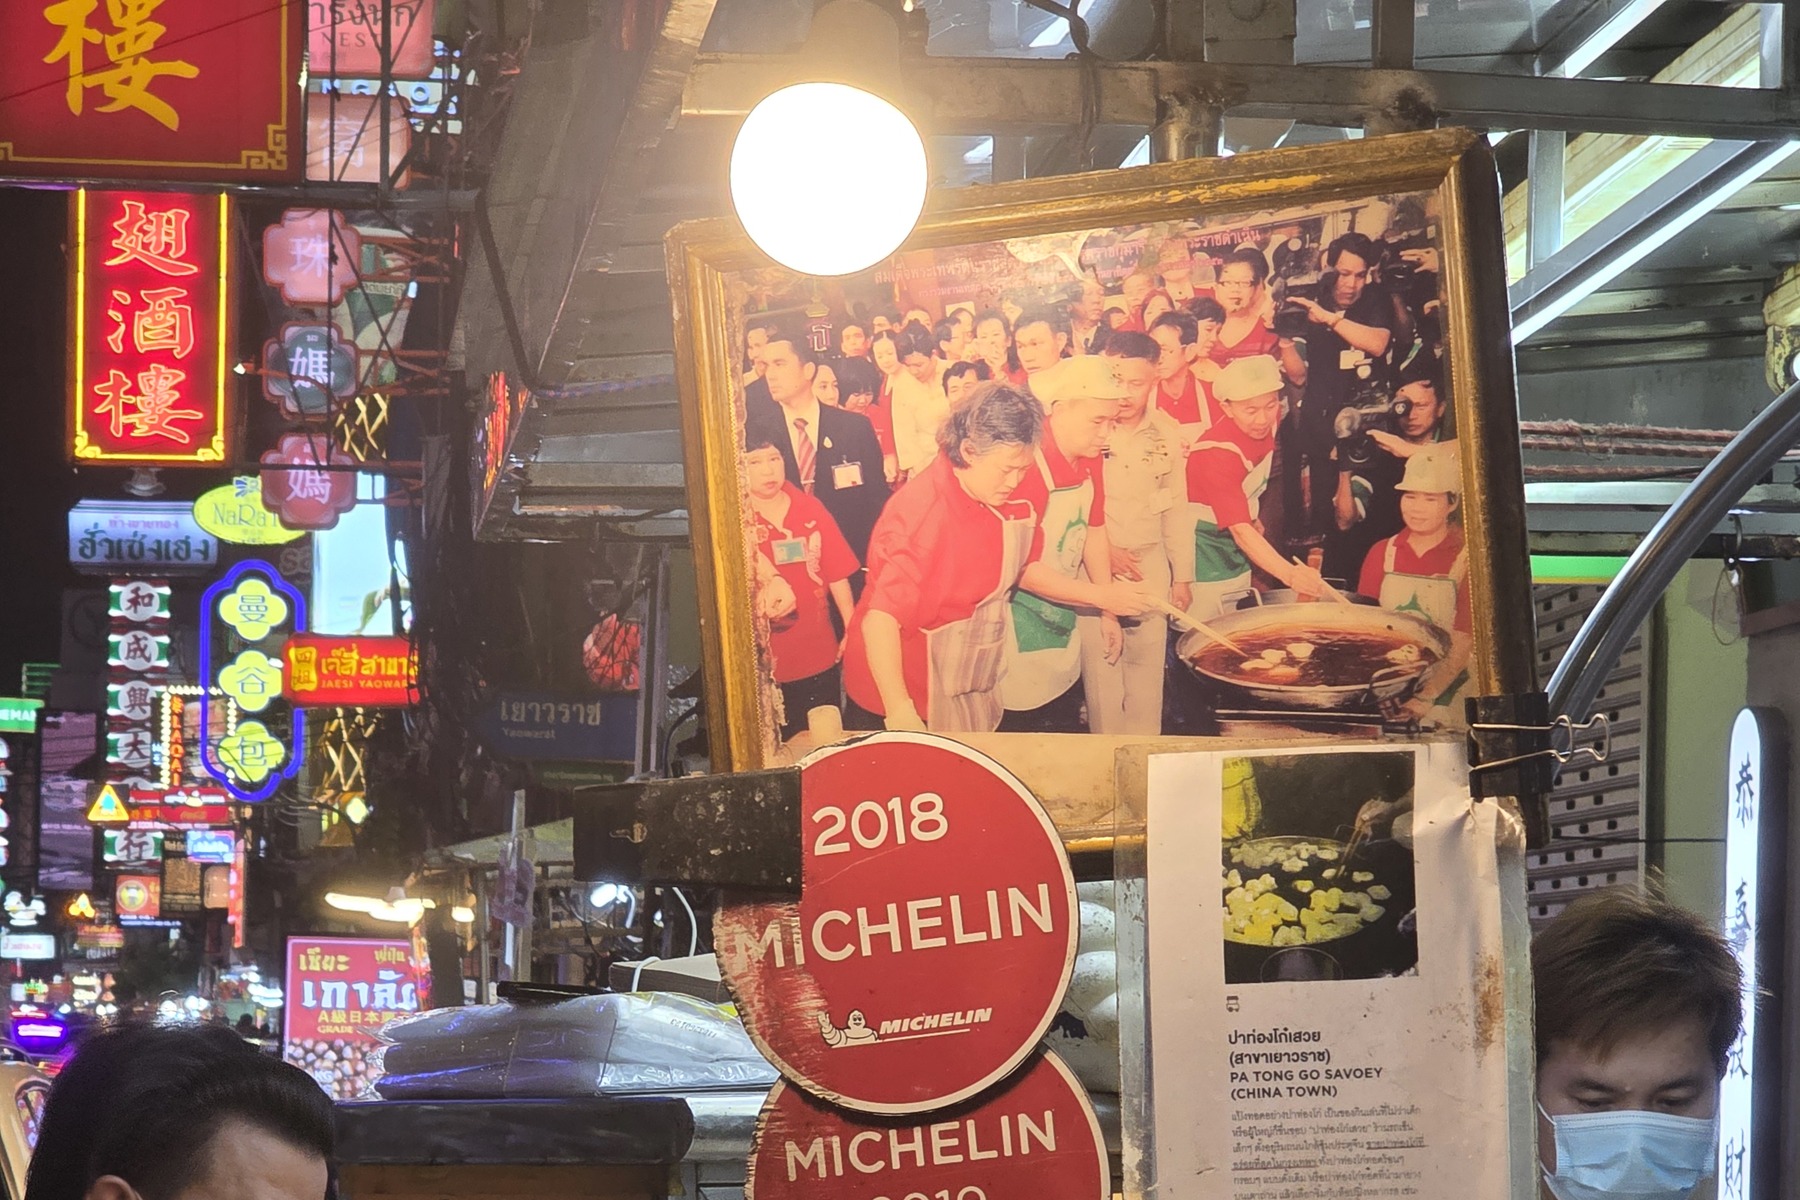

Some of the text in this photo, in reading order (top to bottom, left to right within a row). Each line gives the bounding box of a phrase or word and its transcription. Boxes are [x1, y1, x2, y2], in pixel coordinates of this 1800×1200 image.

[500, 700, 601, 726] เยาวราช
[813, 792, 949, 856] 2018
[734, 884, 1054, 969] MICHELIN
[879, 1008, 993, 1036] MICHELIN
[1228, 1027, 1321, 1045] ปาท่องโก๋เสวย
[1229, 1048, 1331, 1068] (สาขาเยาวราช)
[1230, 1067, 1384, 1083] PA TONG GO SAVOEY
[1231, 1085, 1338, 1101] (CHINA TOWN)
[784, 1110, 1058, 1183] MICHELIN
